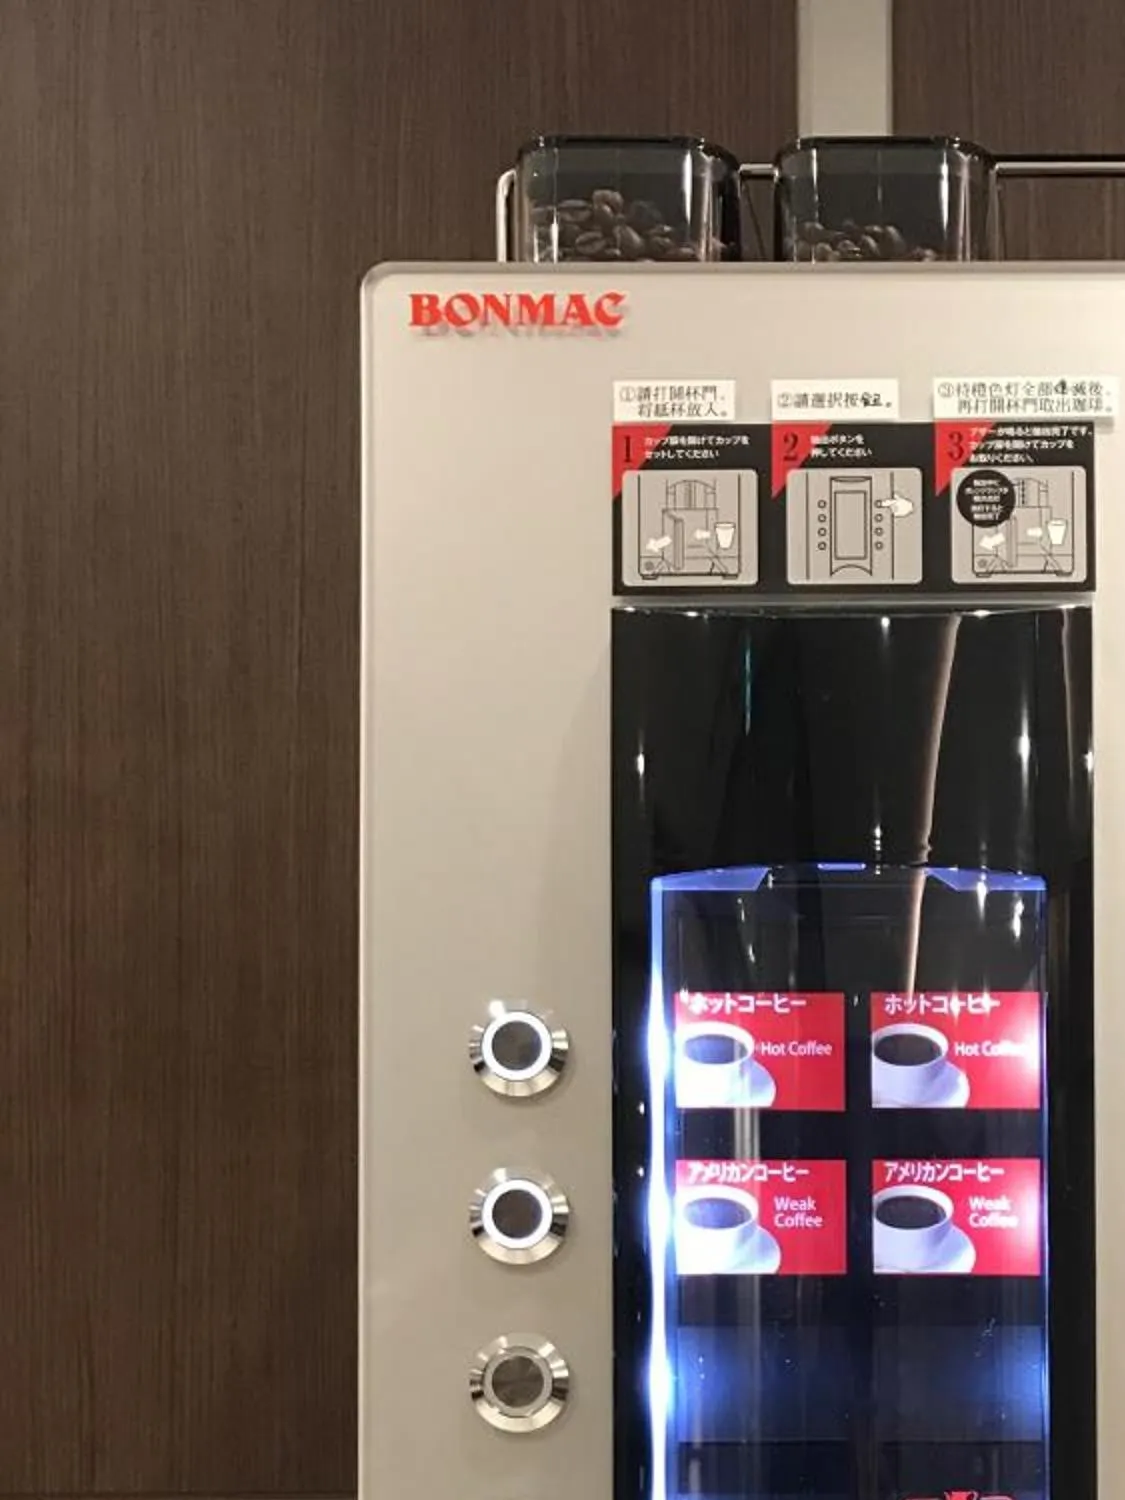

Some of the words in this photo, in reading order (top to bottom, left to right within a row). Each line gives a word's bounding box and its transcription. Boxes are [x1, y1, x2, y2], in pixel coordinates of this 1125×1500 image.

[408, 291, 627, 328] BONMAC
[623, 434, 632, 463] 1
[782, 431, 799, 462] 2
[947, 430, 966, 462] 3
[687, 992, 807, 1014] ホットコーヒー
[884, 992, 1001, 1015] ホットコーヒー
[760, 1041, 785, 1056] Hot
[788, 1040, 833, 1057] Coffee
[955, 1042, 979, 1056] Hot
[687, 1161, 810, 1182] アメリカンコーヒー
[884, 1161, 1005, 1181] アメリカンコーヒー
[774, 1196, 816, 1210] Weak
[969, 1196, 1012, 1211] Weak
[774, 1212, 823, 1227] Coffee
